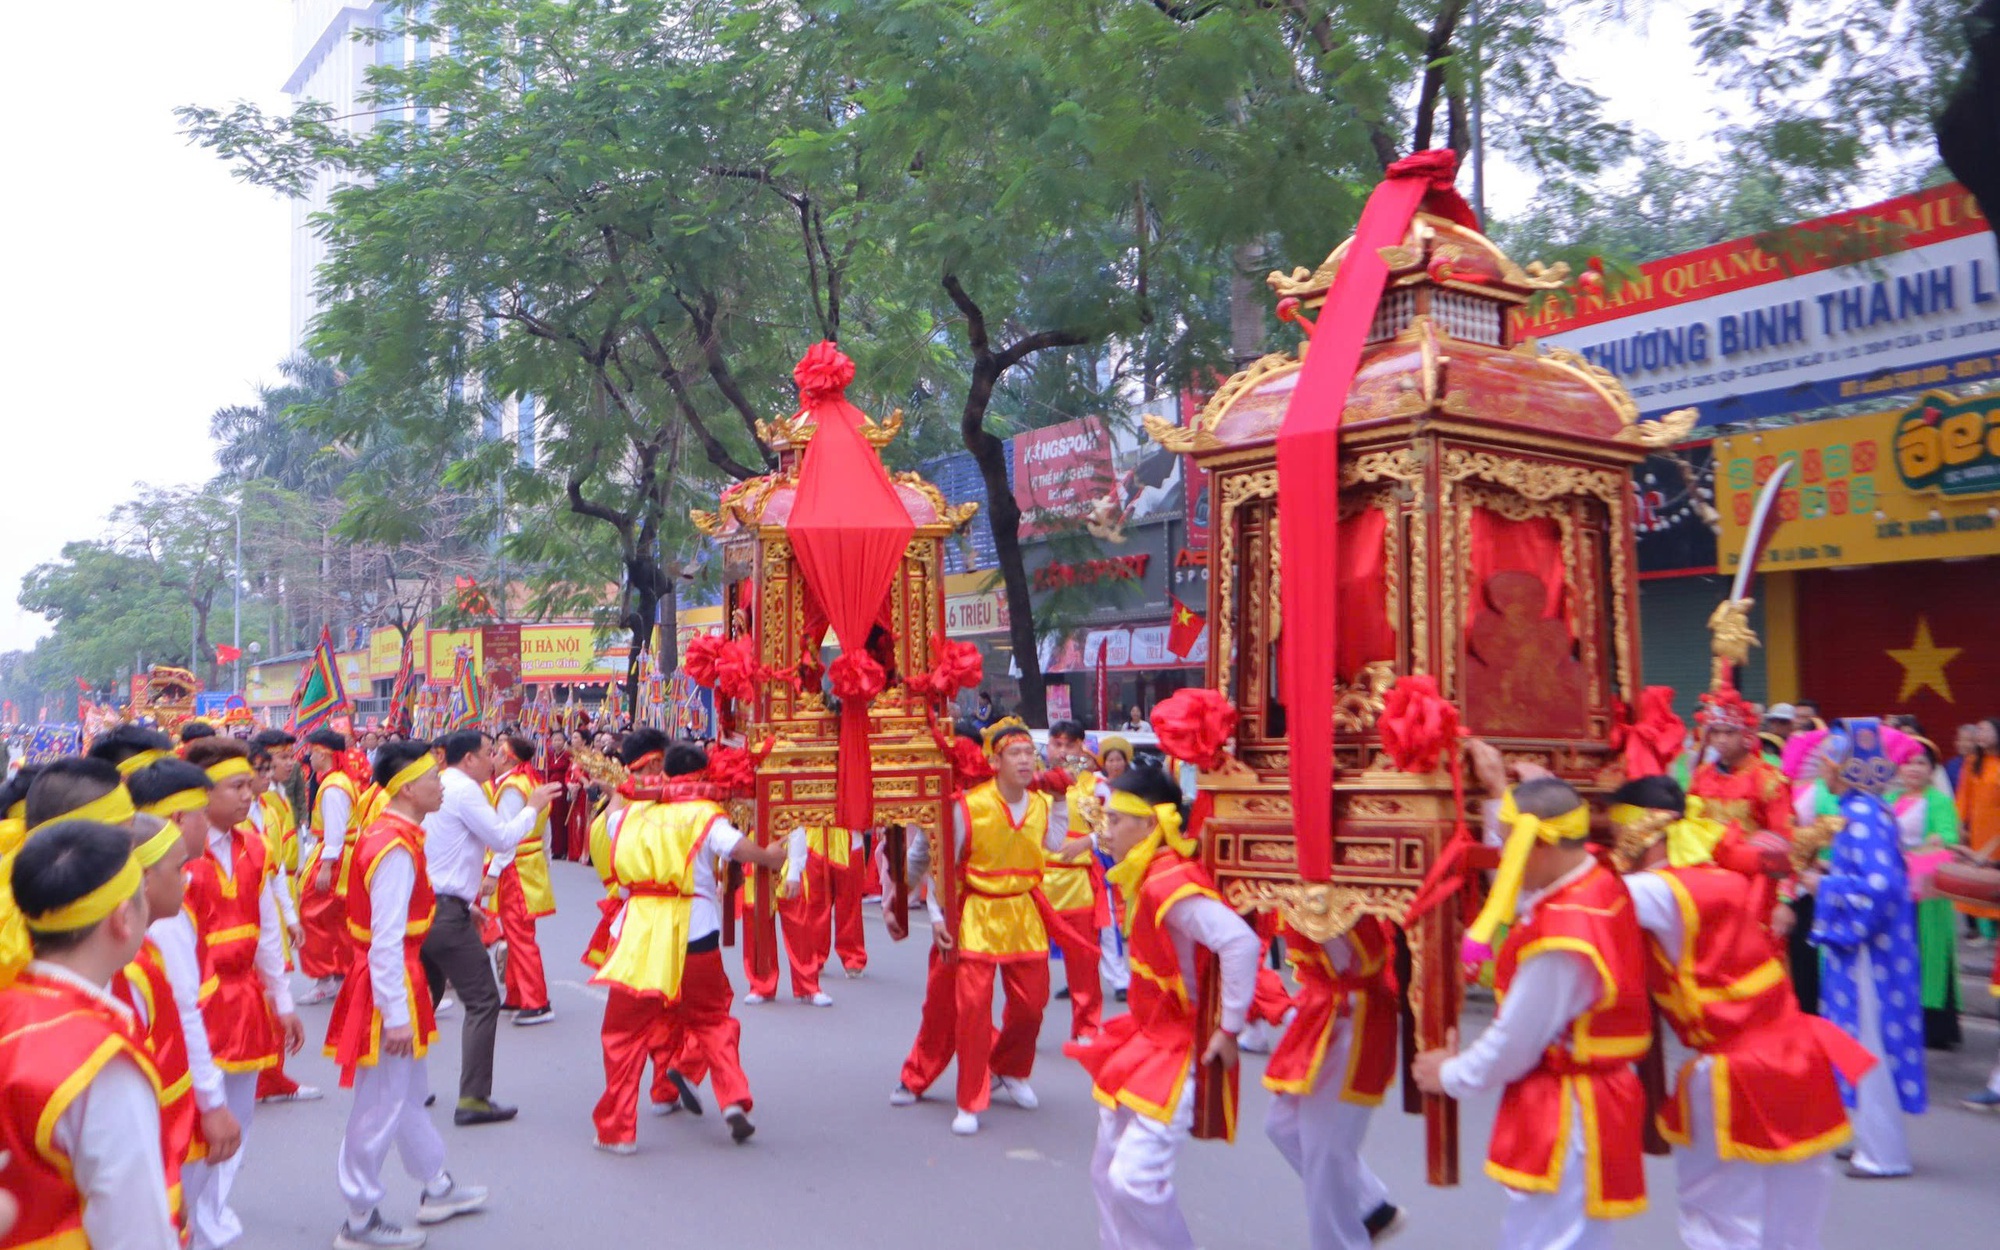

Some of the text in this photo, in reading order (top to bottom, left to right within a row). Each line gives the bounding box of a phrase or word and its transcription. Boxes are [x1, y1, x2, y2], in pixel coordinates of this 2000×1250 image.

[1662, 248, 1779, 298] QUANG
[1719, 299, 1803, 356] BINH
[1816, 265, 1954, 336] THANH
[959, 598, 991, 628] TRIỆU
[535, 635, 554, 653] HÀ
[556, 635, 580, 655] NỘI
